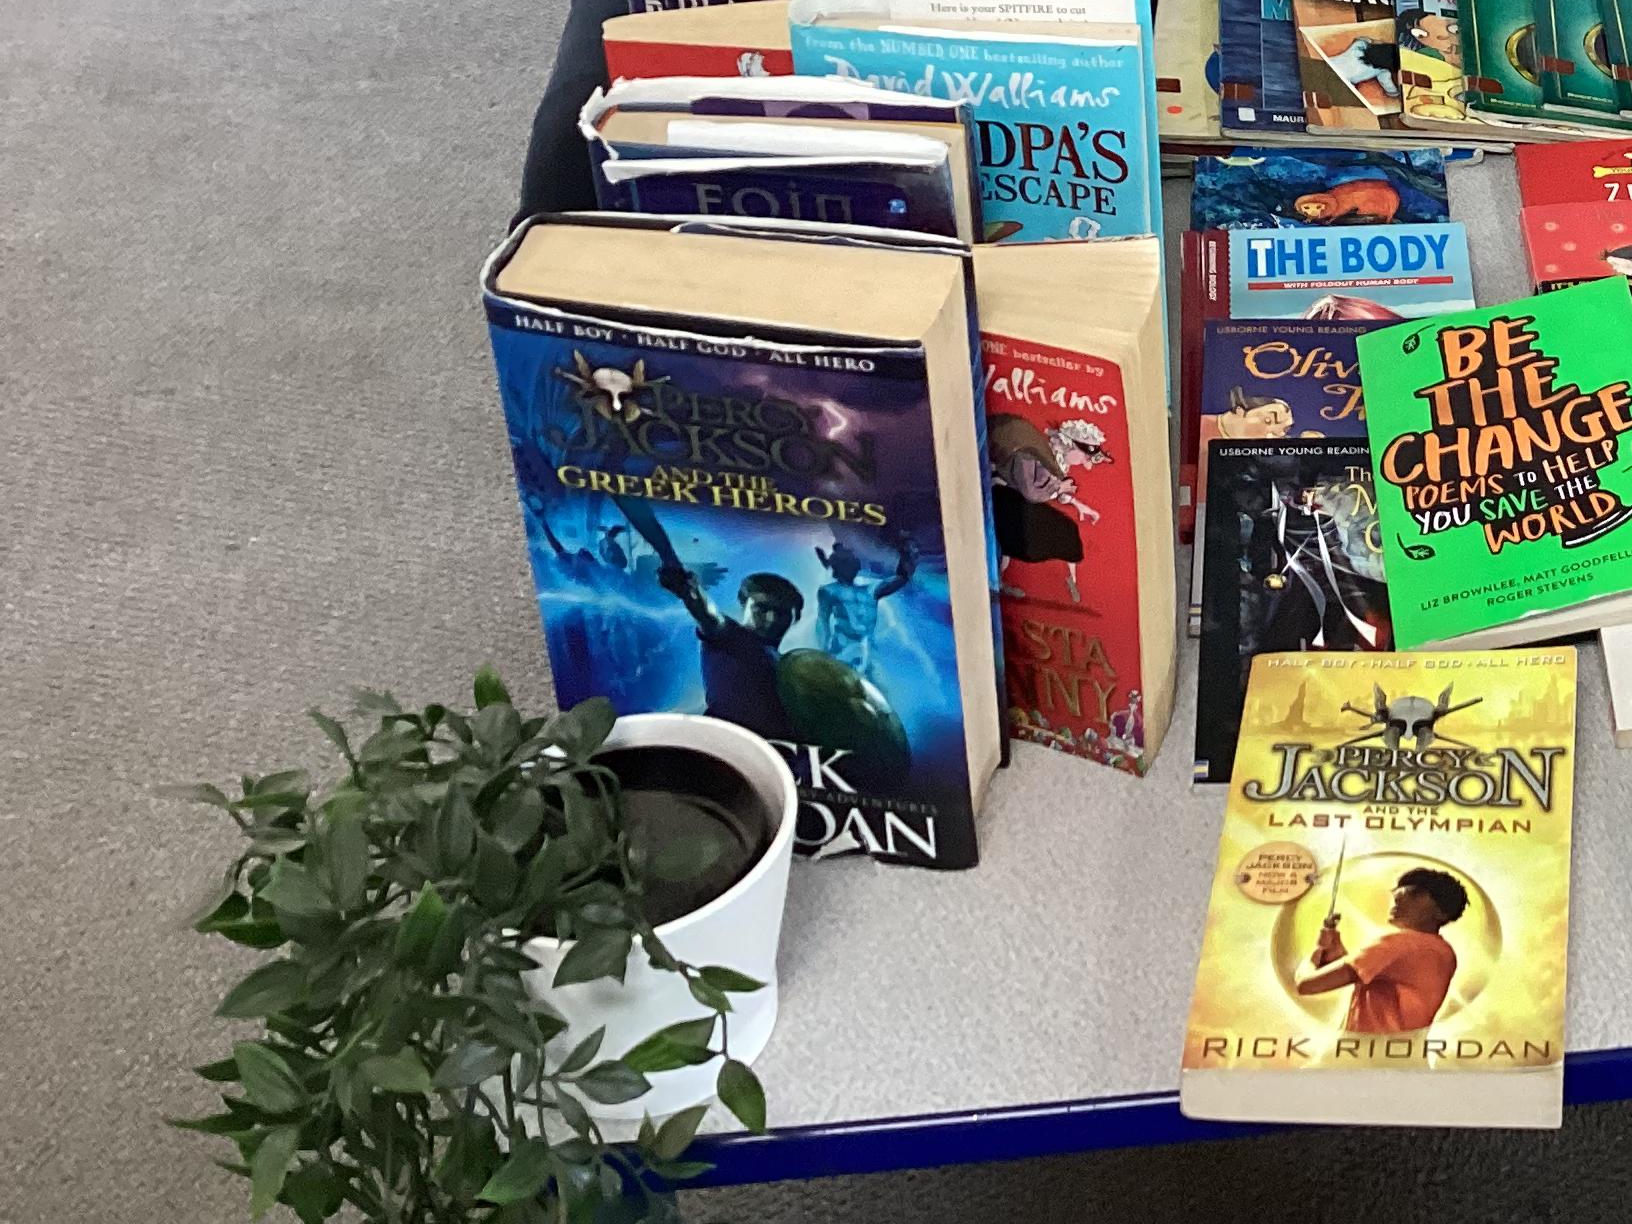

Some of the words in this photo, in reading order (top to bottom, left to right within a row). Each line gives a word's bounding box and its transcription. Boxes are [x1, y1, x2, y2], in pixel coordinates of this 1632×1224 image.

[932, 3, 956, 15] Here
[959, 4, 968, 14] is
[972, 5, 995, 17] your
[998, 4, 1054, 15] SPITFIRE
[1056, 5, 1068, 15] to
[1070, 5, 1086, 15] cut
[1248, 238, 1326, 276] THE
[1340, 235, 1449, 274] BODY
[515, 315, 564, 333] HALF
[573, 325, 613, 342] BOY
[638, 334, 689, 352] HALF
[697, 341, 746, 359] GOD
[769, 351, 806, 366] ALL
[815, 356, 875, 373] HERO
[1443, 315, 1538, 378] BE
[1416, 360, 1576, 426] THE
[558, 466, 698, 503] GREEK
[712, 486, 886, 526] HEROES
[1406, 474, 1504, 508] POEMS
[1514, 472, 1537, 487] TO
[1542, 440, 1616, 483] HELP
[1416, 505, 1470, 534] YOU
[1479, 488, 1547, 520] SAVE
[1555, 476, 1597, 500] THE
[1485, 492, 1617, 553] WORLD
[1422, 598, 1439, 610] LIZ
[1442, 580, 1520, 605] BROWNLEE,
[1524, 568, 1557, 585] MATT
[1487, 586, 1532, 605] ROGER
[1537, 573, 1593, 595] STEVENS
[1246, 744, 1566, 812] JACKSON
[1337, 747, 1473, 770] PERCY
[1269, 813, 1351, 828] LAST
[1366, 815, 1531, 833] OLYMPIAN
[1203, 1037, 1311, 1060] RICK
[1335, 1037, 1551, 1060] RIORDAN
